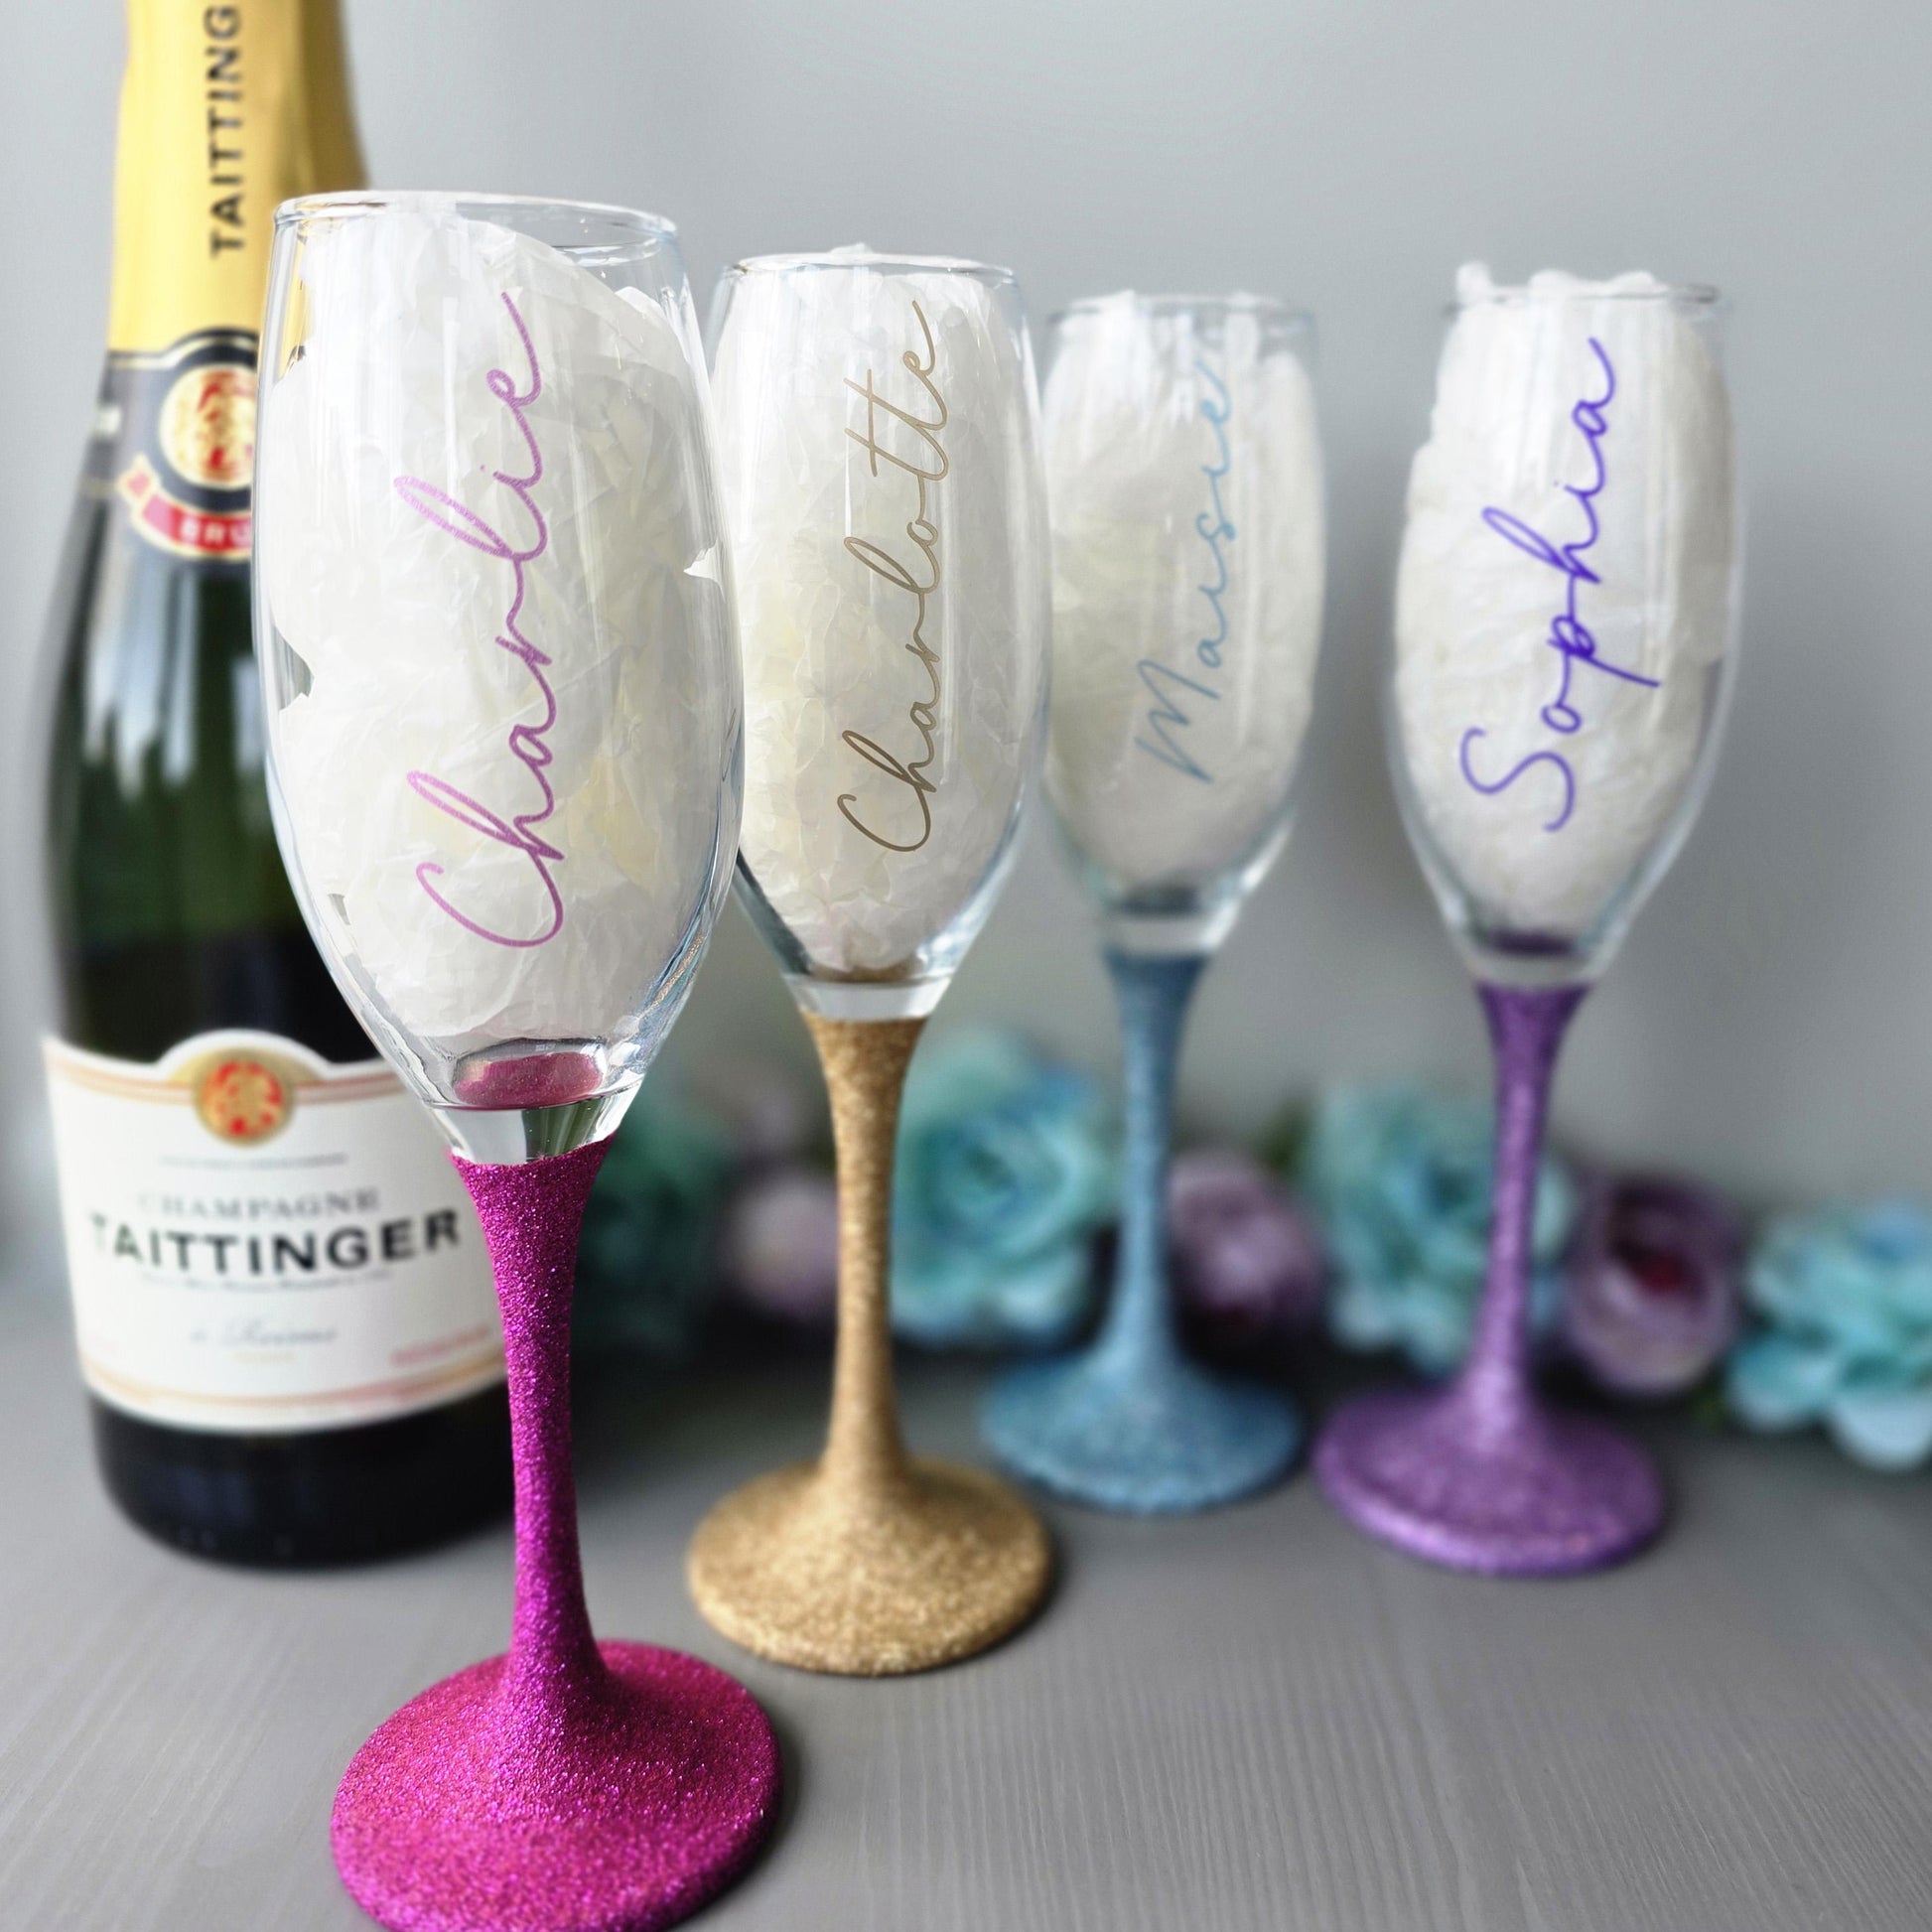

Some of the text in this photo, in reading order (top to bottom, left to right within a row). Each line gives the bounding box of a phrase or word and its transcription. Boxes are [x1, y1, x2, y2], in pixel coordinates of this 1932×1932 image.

[393, 291, 566, 948] Charlie
[837, 299, 949, 852] Charlotte
[1459, 337, 1661, 832] Sophia
[89, 1207, 460, 1277] TAITTINGER
[137, 1186, 379, 1222] CHAMPAGNE
